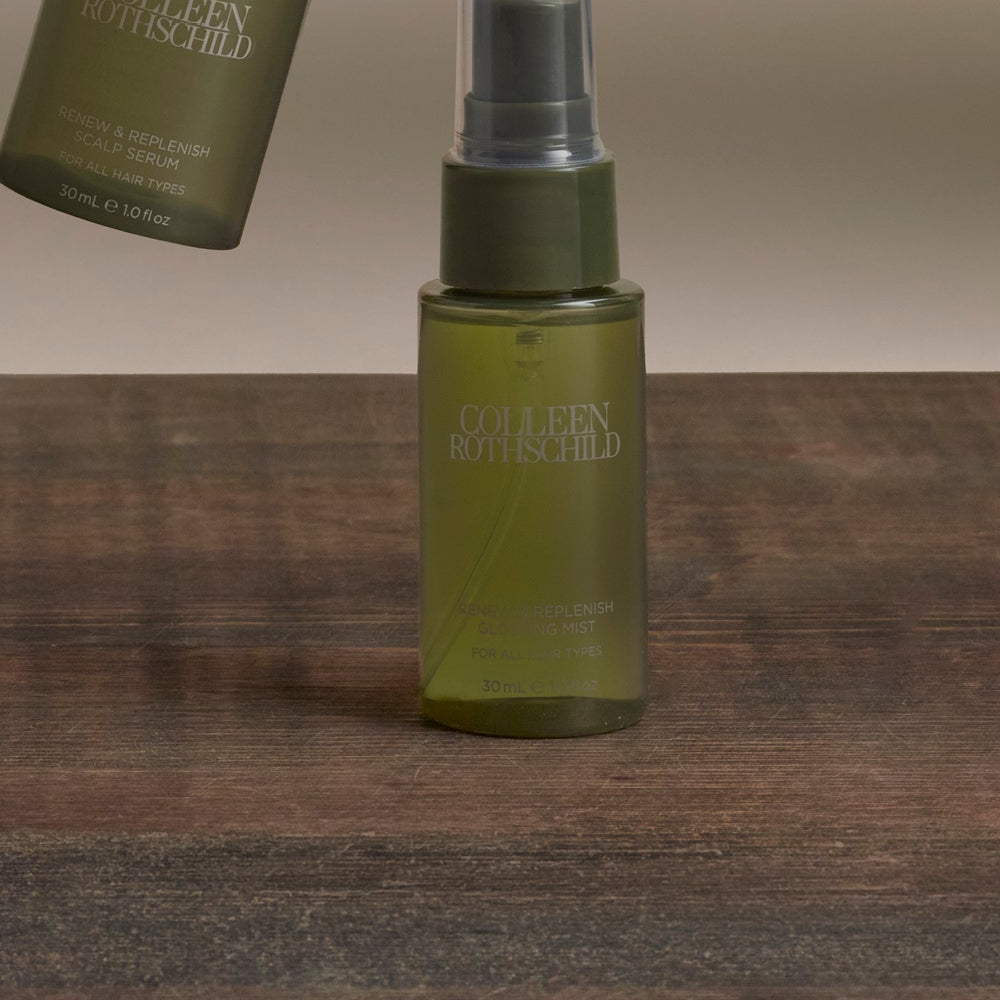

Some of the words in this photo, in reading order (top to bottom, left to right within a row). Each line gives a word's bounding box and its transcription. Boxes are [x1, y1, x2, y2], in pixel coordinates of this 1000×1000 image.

[58, 105, 111, 133] RENEW
[114, 125, 124, 138] &
[128, 129, 211, 158] REPLENISH
[74, 130, 123, 155] SCALP
[126, 147, 180, 171] SERUM
[57, 152, 83, 168] FOR
[86, 161, 108, 176] ALL
[112, 170, 144, 186] HAIR
[148, 178, 186, 196] TYPES
[59, 184, 77, 200] 30
[78, 192, 99, 208] mL
[123, 204, 141, 219] 1.0
[460, 402, 610, 436] COLLEEN
[450, 432, 621, 464] ROTHSCHILD
[534, 601, 614, 618] REPLENISH
[563, 620, 596, 634] MIST
[472, 647, 496, 659] FOR
[566, 645, 602, 658] TYPES
[483, 680, 500, 693] 30
[503, 681, 526, 694] mL
